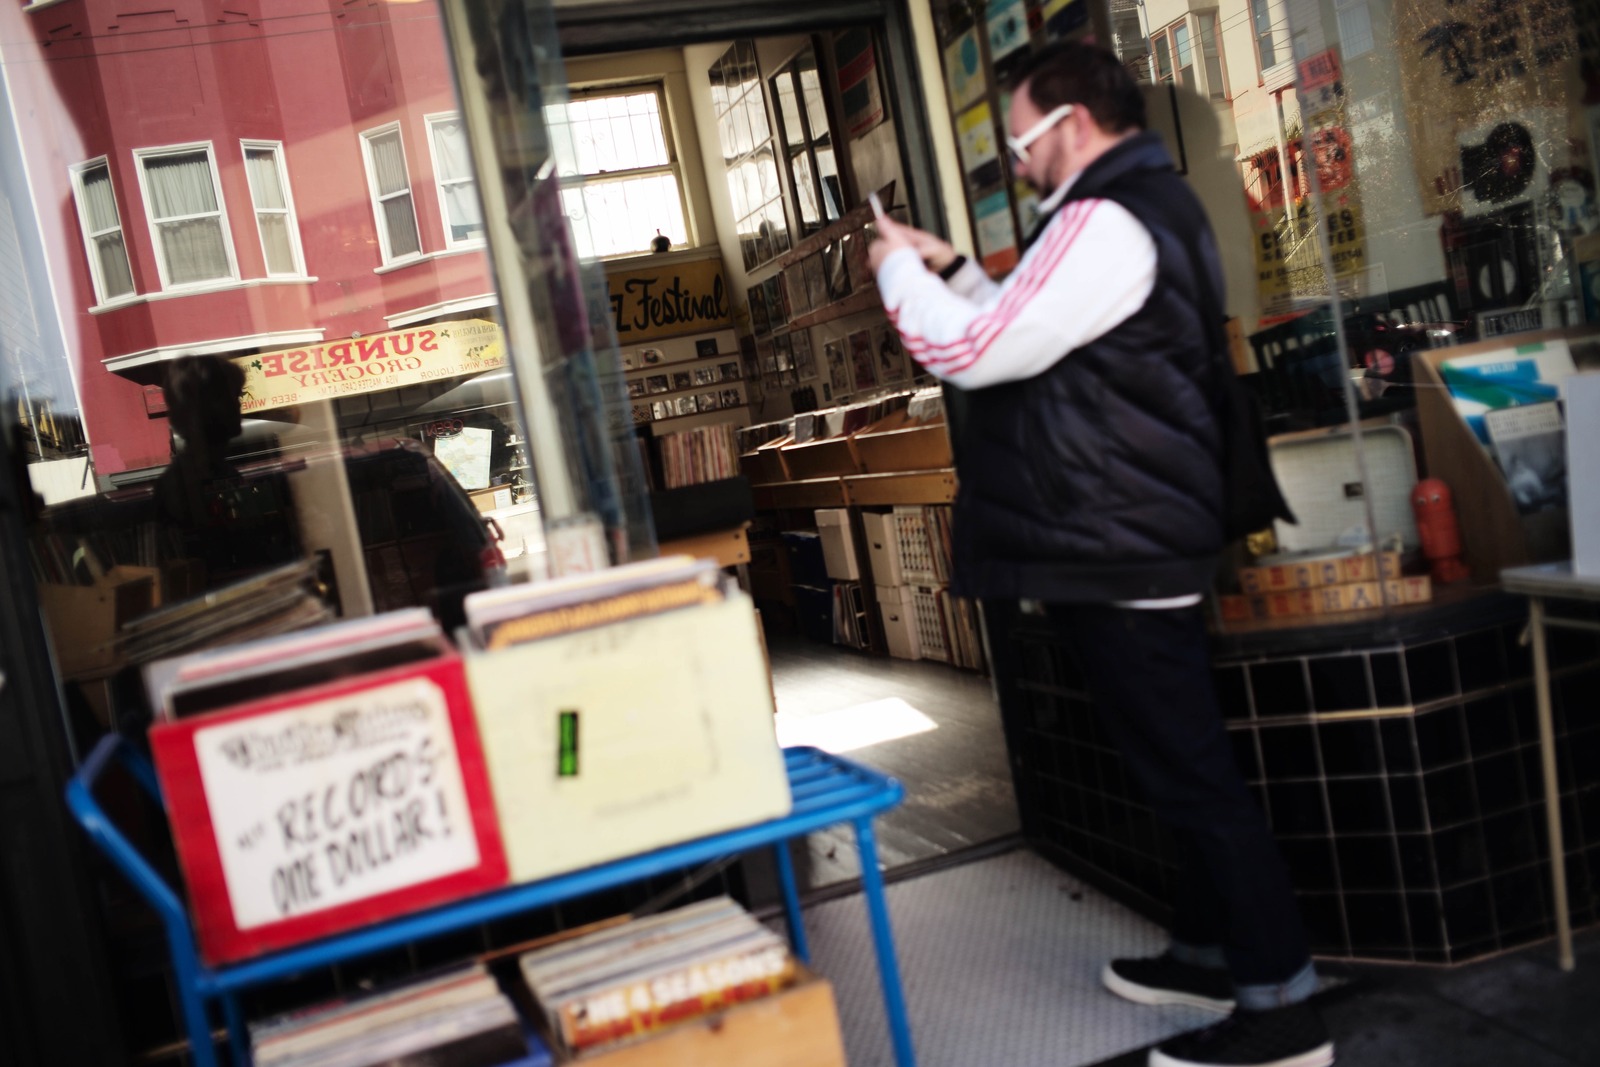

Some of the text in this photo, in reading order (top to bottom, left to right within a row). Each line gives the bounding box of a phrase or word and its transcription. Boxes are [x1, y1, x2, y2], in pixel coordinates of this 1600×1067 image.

[624, 273, 729, 330] Festival
[278, 735, 438, 850] RECORDS
[270, 787, 451, 915] ONE DOLLAR!
